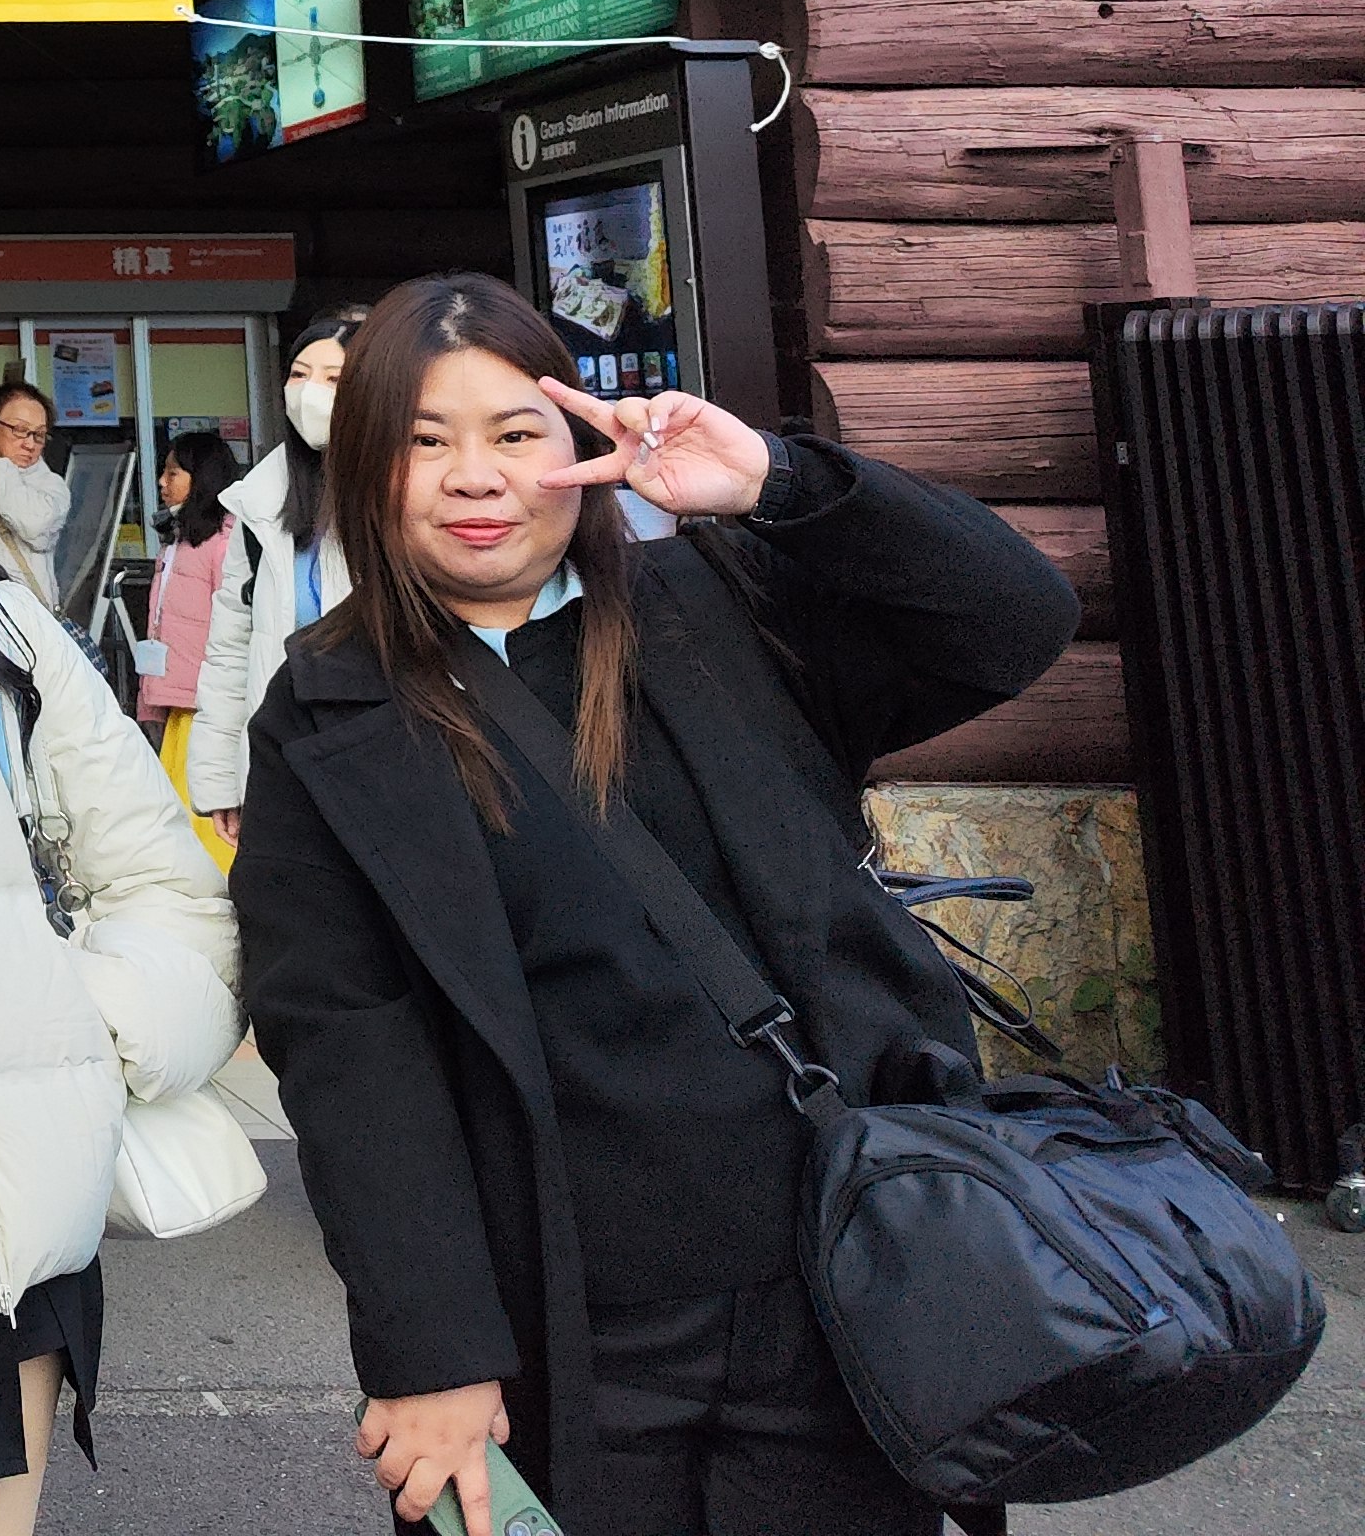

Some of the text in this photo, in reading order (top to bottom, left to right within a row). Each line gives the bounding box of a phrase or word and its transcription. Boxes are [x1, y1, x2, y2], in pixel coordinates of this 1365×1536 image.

[540, 93, 669, 140] Gora Station Information
